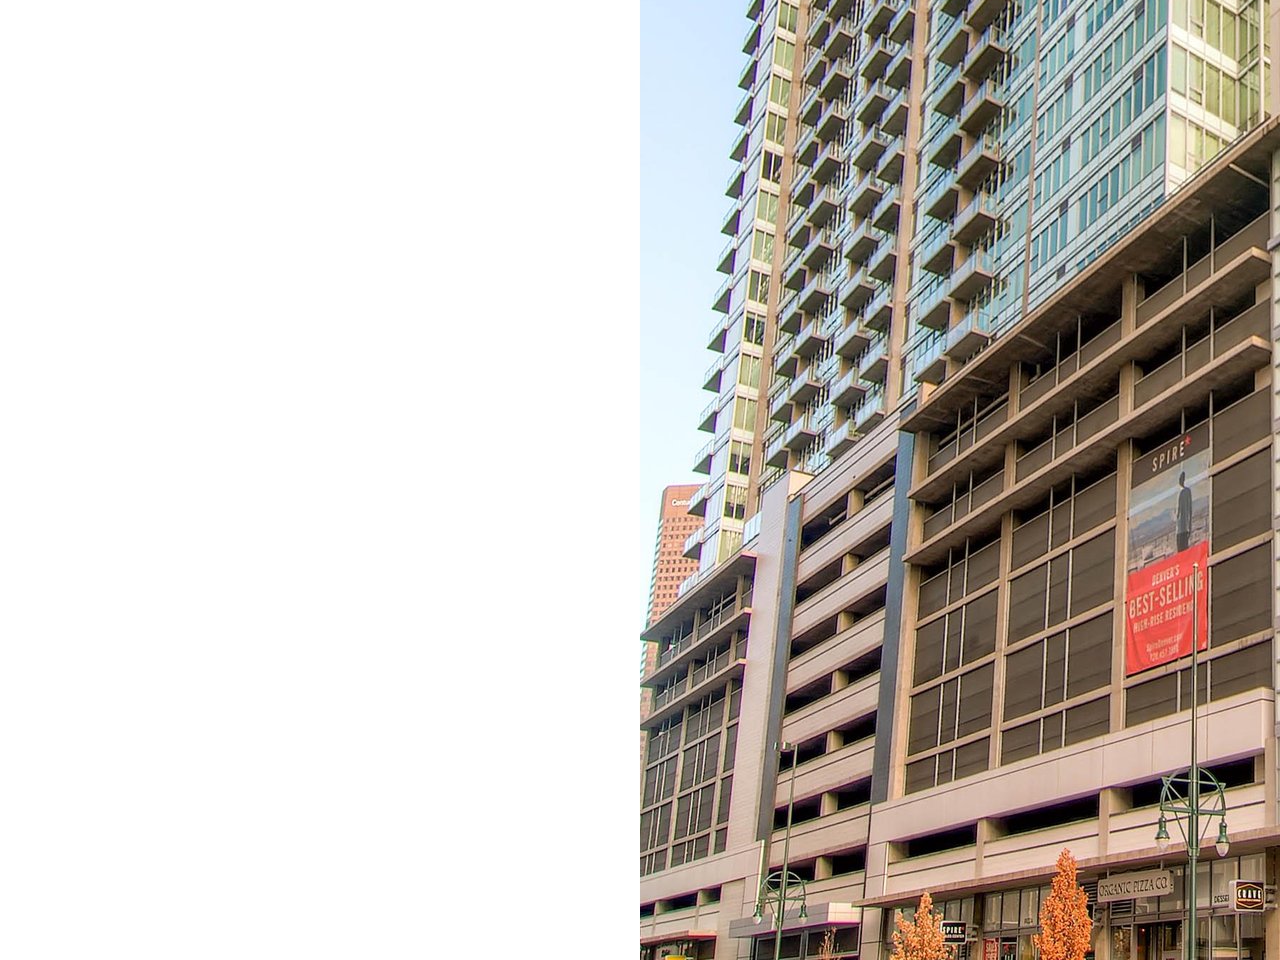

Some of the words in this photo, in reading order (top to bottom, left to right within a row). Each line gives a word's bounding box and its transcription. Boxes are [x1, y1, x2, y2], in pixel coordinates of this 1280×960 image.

[1152, 441, 1185, 472] SPIRE
[1129, 571, 1204, 619] BEST-SELLING
[1099, 880, 1132, 897] ORGANIC
[1133, 878, 1154, 893] PIZZA
[1237, 889, 1261, 899] CRAVE
